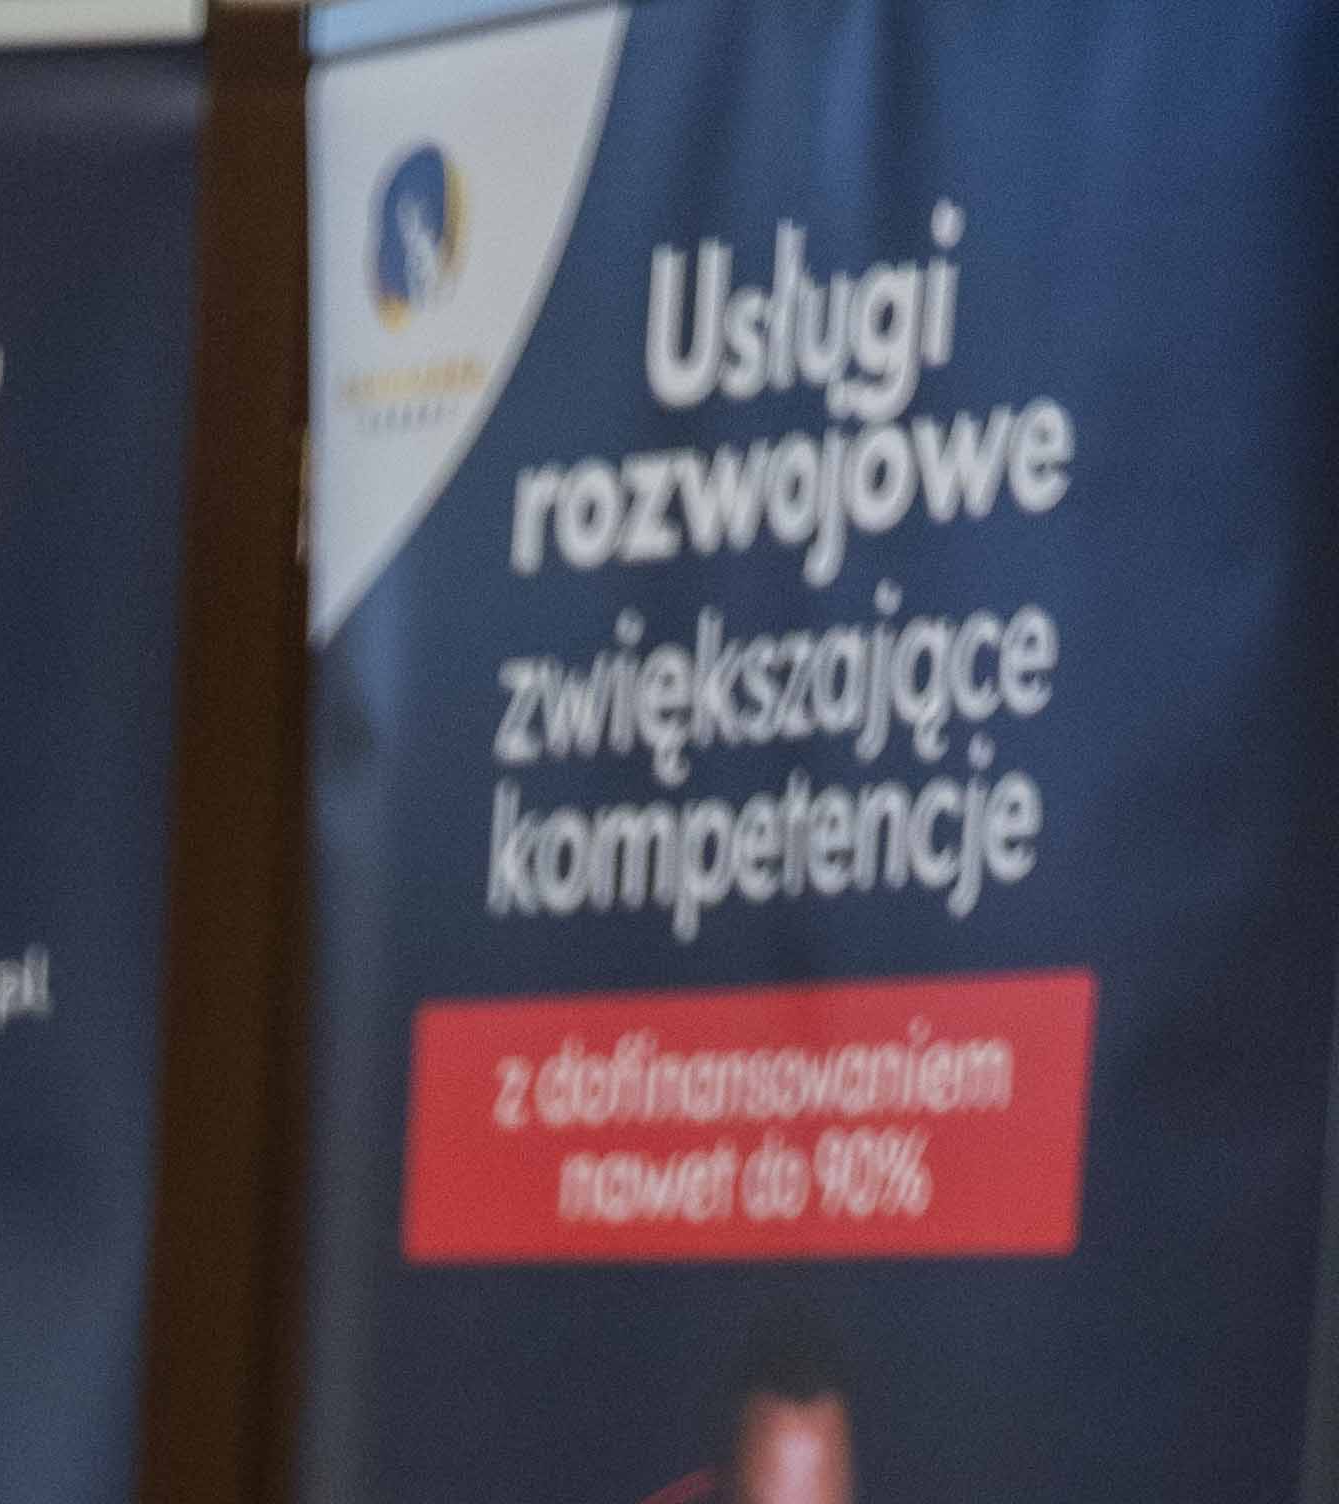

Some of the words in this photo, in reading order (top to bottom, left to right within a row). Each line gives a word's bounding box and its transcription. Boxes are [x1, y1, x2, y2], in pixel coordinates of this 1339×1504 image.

[645, 203, 968, 420] Usługi
[510, 398, 1073, 584] rozwojowe
[493, 578, 1060, 786] zwiększające
[485, 738, 1045, 941] kompetencje
[493, 1055, 532, 1130] z
[534, 1020, 1014, 1125] dofinansowaniem
[558, 1143, 738, 1222] nawet
[741, 1132, 812, 1220] do
[815, 1125, 933, 1218] 90%
